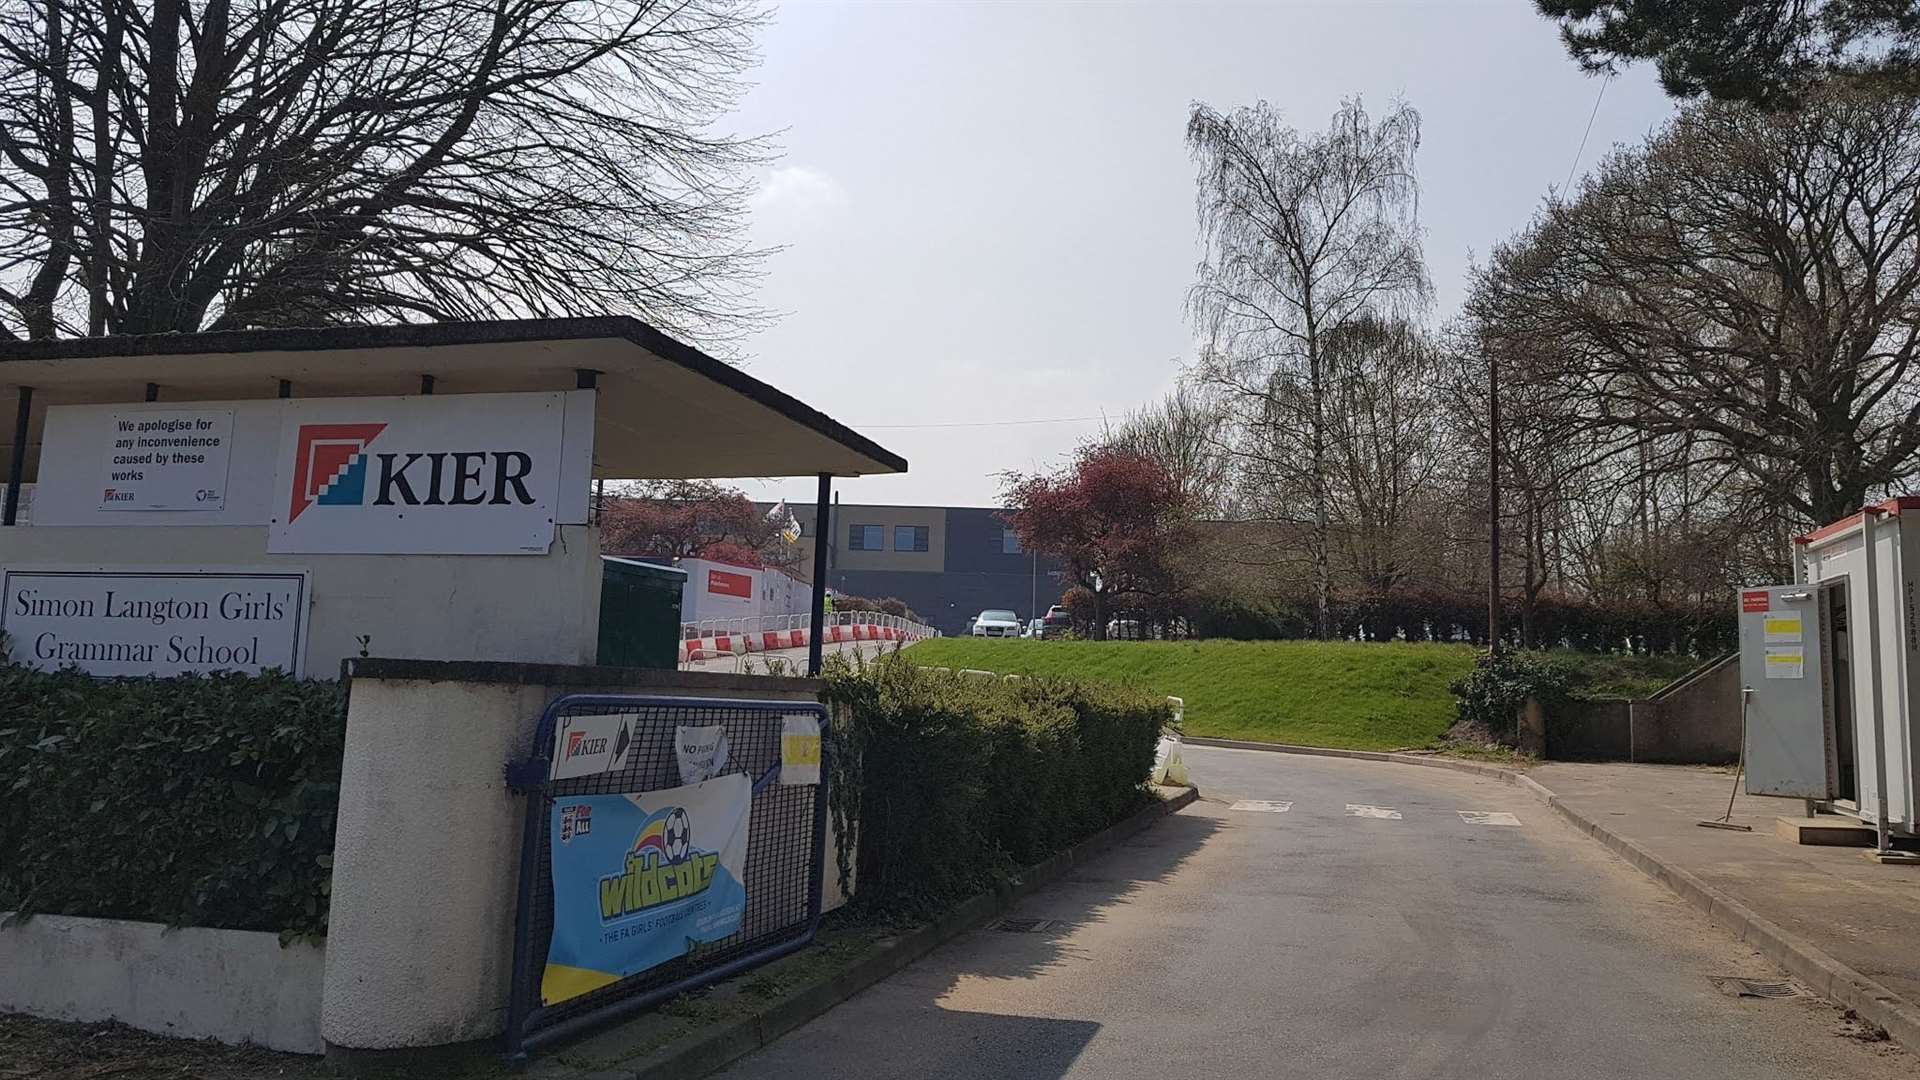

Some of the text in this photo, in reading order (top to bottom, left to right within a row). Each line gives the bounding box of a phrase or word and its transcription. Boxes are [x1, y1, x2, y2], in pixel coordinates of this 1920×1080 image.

[118, 418, 213, 433] We apologise for
[115, 436, 220, 450] any inconvenience
[113, 452, 205, 466] caused by these
[111, 470, 144, 481] works
[373, 450, 536, 507] KIER
[114, 492, 135, 502] KIER
[15, 588, 290, 625] Simon Langton Girls'
[35, 632, 258, 666] Grammar School
[581, 737, 608, 756] KIER
[683, 743, 697, 754] NO
[576, 820, 590, 834] ALL
[604, 930, 619, 944] THE
[620, 928, 630, 939] FA
